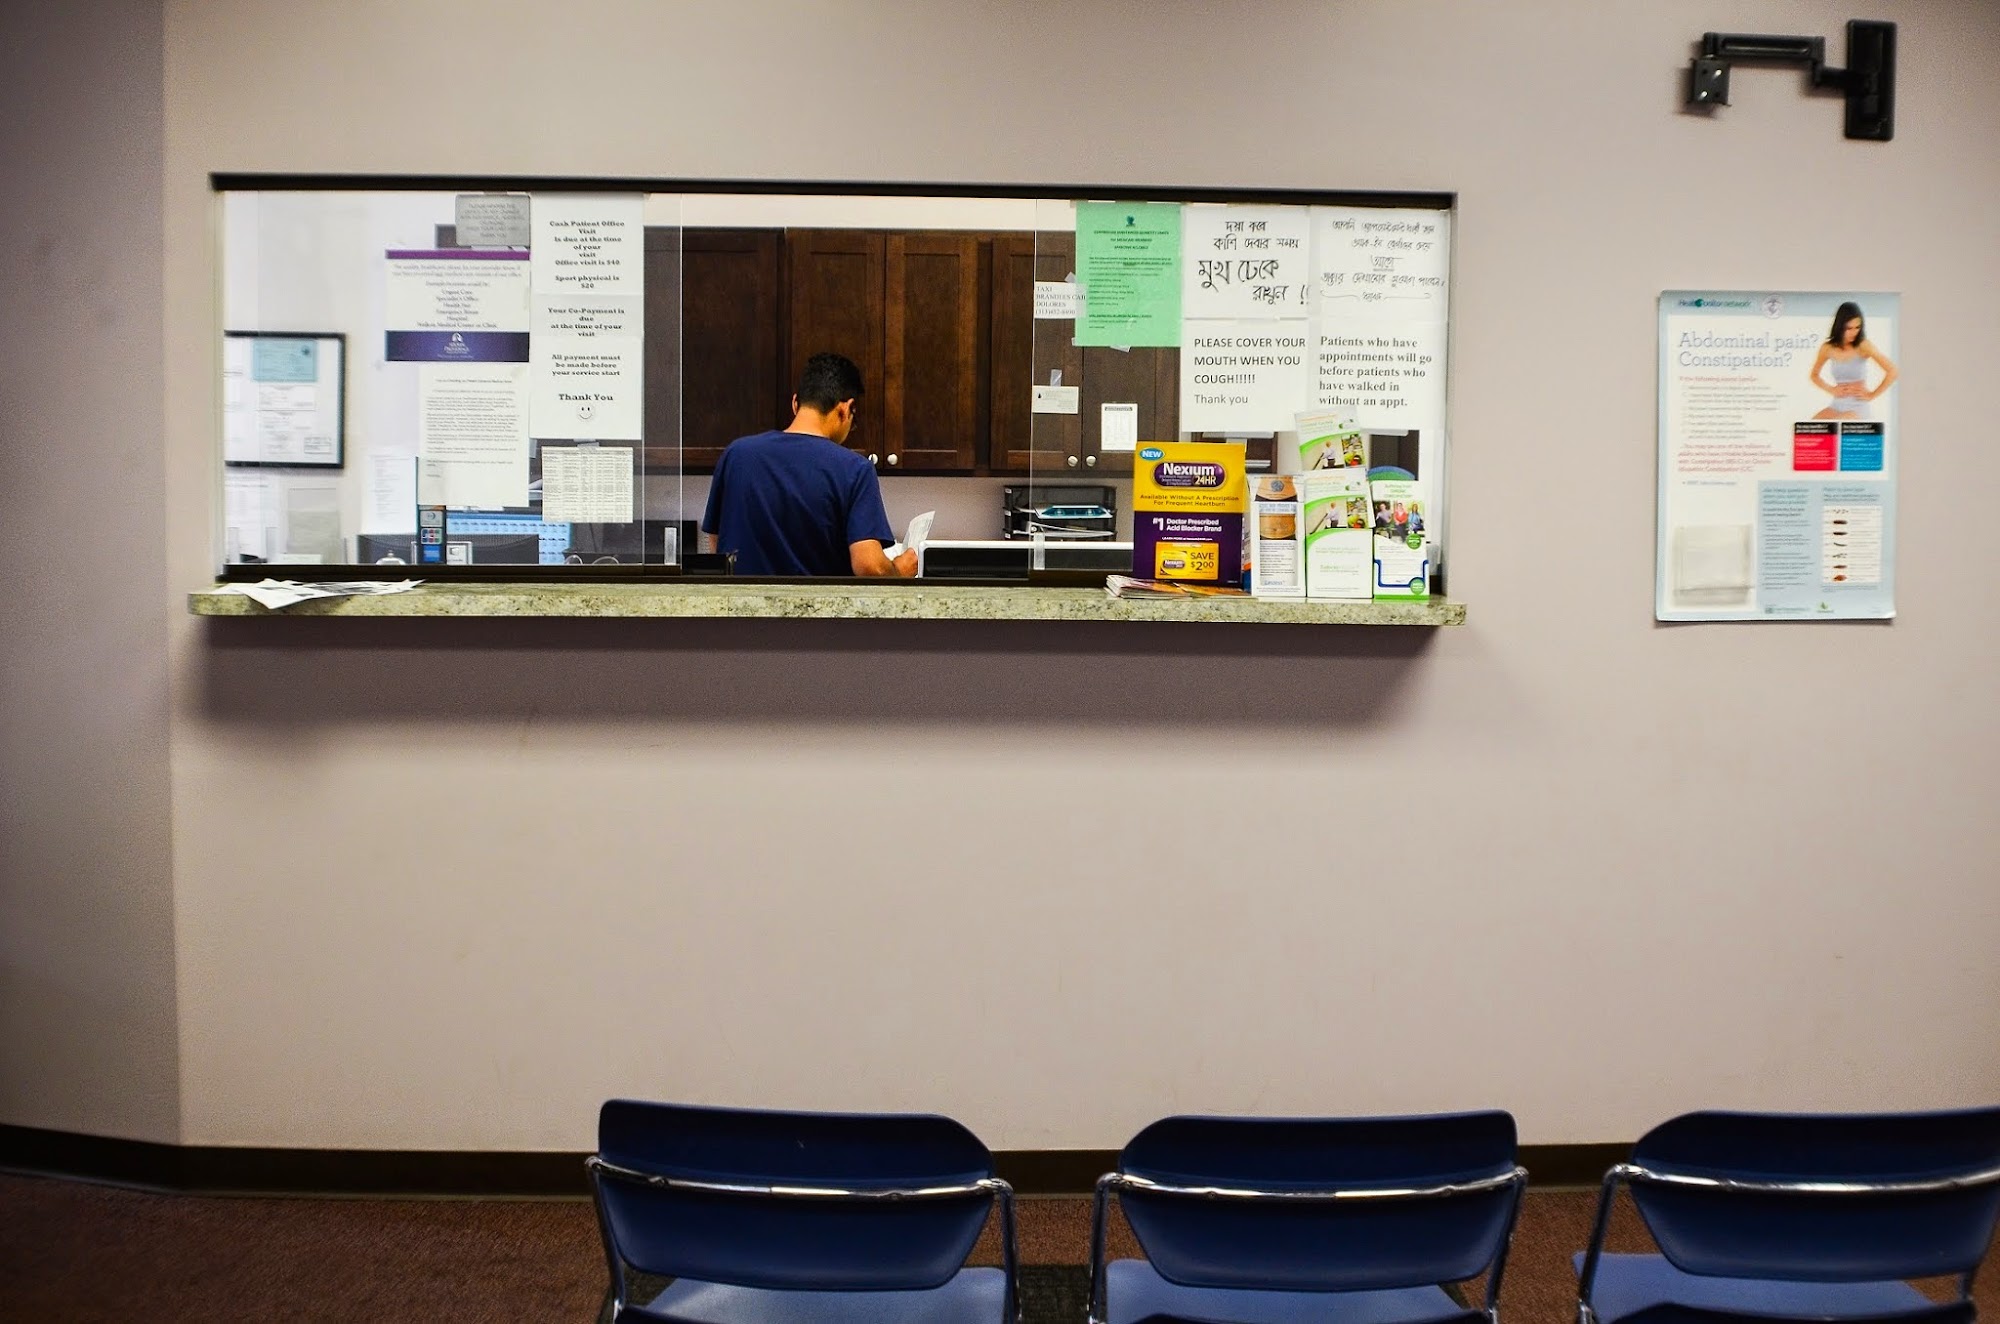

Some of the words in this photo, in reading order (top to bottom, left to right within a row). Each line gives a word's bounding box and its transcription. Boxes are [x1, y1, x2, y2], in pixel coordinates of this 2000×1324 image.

[1225, 221, 1244, 233] দয়া
[1248, 221, 1268, 233] করে
[1198, 260, 1233, 293] মুখ
[1237, 259, 1279, 283] ঢেকে
[1252, 285, 1290, 305] রাখুন
[1194, 338, 1233, 348] PLEASE
[1236, 338, 1272, 348] COVER
[1274, 338, 1306, 348] YOUR
[1320, 336, 1364, 348] Patients
[1367, 336, 1390, 348] who
[1393, 336, 1418, 348] have
[1678, 331, 1770, 349] Abdominal
[1775, 334, 1819, 352] pain?
[1194, 356, 1237, 366] MOUTH
[1239, 356, 1274, 366] WHEN
[1277, 356, 1301, 366] YOU
[1319, 352, 1394, 365] appointments
[1396, 352, 1416, 365] will
[1419, 356, 1432, 365] go
[1678, 351, 1792, 370] Constipation?
[1319, 366, 1354, 376] before
[1357, 367, 1400, 379] patients
[1403, 367, 1426, 378] who
[1194, 374, 1256, 384] COUGH!!!!!
[1319, 381, 1344, 392] have
[1347, 381, 1387, 392] walked
[1389, 381, 1400, 392] in
[558, 393, 592, 401] Thank
[594, 393, 614, 401] You
[1194, 394, 1227, 404] Thank
[1229, 396, 1249, 406] you
[1318, 396, 1360, 406] without
[1363, 399, 1376, 407] an
[1379, 397, 1408, 409] appt.
[1142, 450, 1162, 459] NEW
[1163, 463, 1215, 476] Nexium
[1194, 476, 1217, 486] 24HR
[1152, 517, 1164, 531] #1
[1190, 552, 1214, 560] SAVE
